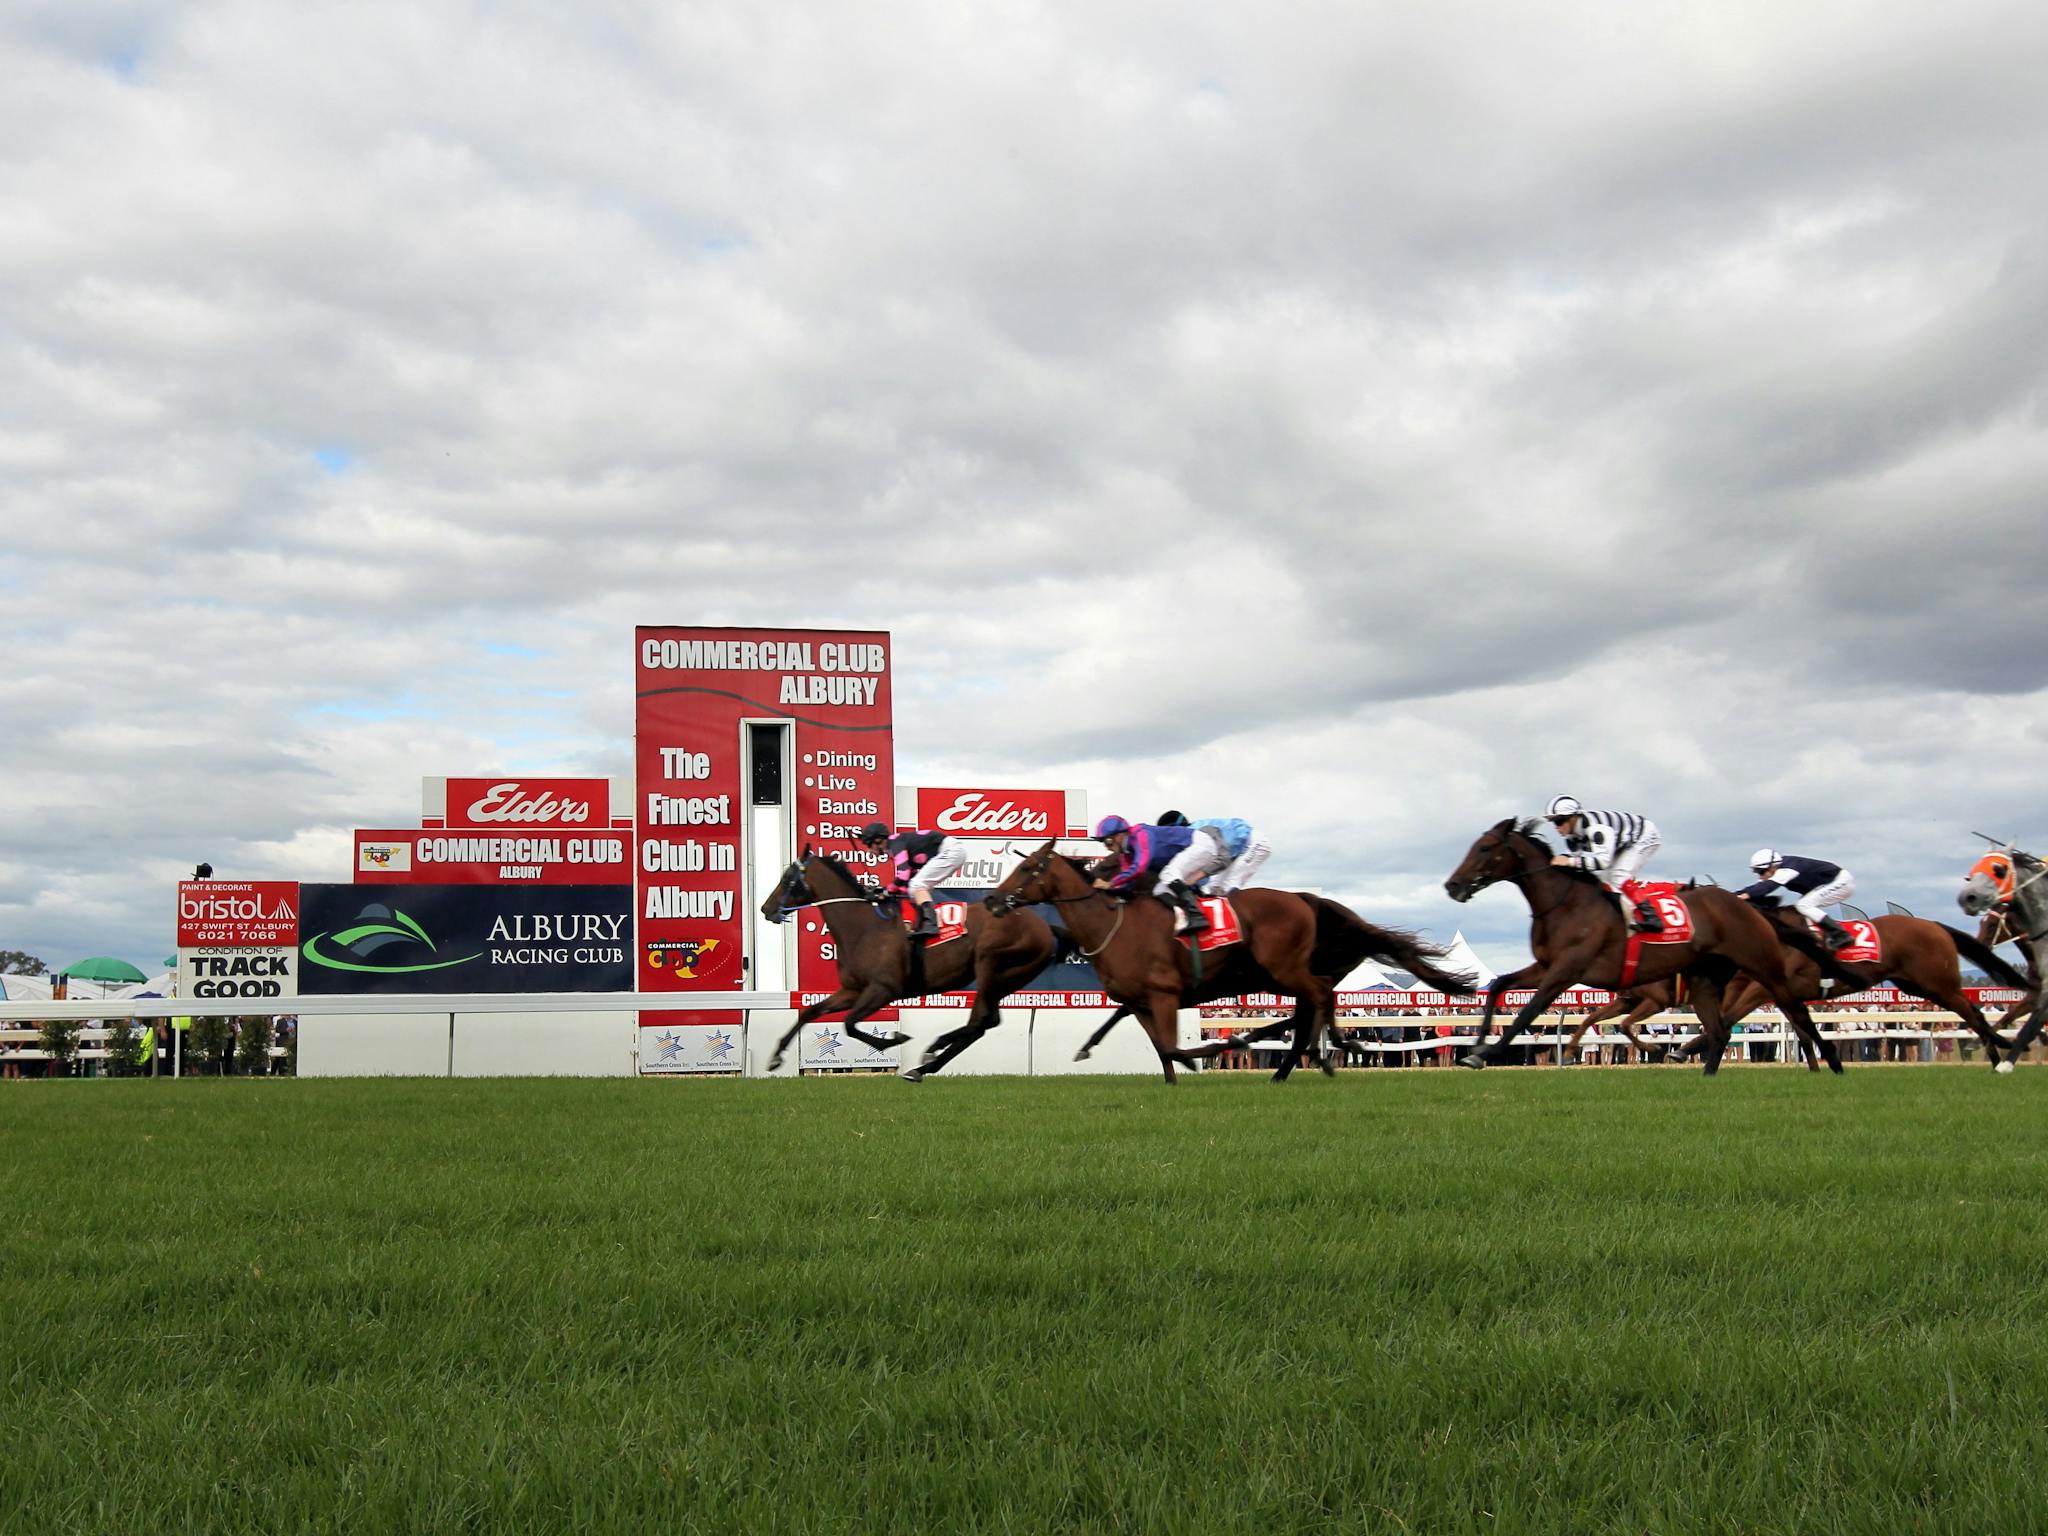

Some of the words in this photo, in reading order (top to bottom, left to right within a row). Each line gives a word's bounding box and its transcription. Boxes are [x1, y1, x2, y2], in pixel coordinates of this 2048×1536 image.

[642, 639, 816, 671] COMMERCIAL
[819, 643, 885, 673] CLUB
[779, 675, 878, 706] ALBURY
[660, 747, 710, 779] The
[816, 751, 877, 771] Dining
[818, 774, 856, 791] Live
[467, 783, 589, 823] Elders
[648, 793, 731, 825] Finest
[818, 797, 878, 815] Bands
[936, 793, 1048, 831] Elders
[820, 822, 862, 838] Bars
[416, 838, 564, 863] COMMERCIAL
[566, 838, 624, 864] CLUB
[642, 839, 706, 872] Club
[709, 842, 735, 871] in
[499, 866, 543, 879] ALBURY
[180, 892, 267, 920] bristol
[645, 886, 734, 921] Albury
[1656, 898, 1686, 927] 5
[934, 903, 963, 928] 10
[197, 931, 234, 940] 6021
[240, 931, 277, 940] 7066
[486, 914, 628, 942] ALBURY
[1853, 922, 1876, 948] 2
[198, 947, 262, 955] CONDITION
[266, 947, 283, 955] OF
[491, 948, 568, 964] RACING
[574, 948, 624, 964] CLUB
[189, 956, 289, 977] TRACK
[193, 979, 281, 998] GOOD
[1337, 992, 1413, 1005] COMMERCIAL
[1416, 992, 1446, 1005] CLUB
[1505, 992, 1578, 1005] COMCIAL
[1581, 991, 1610, 1004] CLUB
[925, 993, 967, 1008] Albury
[998, 993, 1067, 1006] MMERCIAL
[1070, 993, 1102, 1006] CLUB
[1246, 993, 1277, 1006] CLUB
